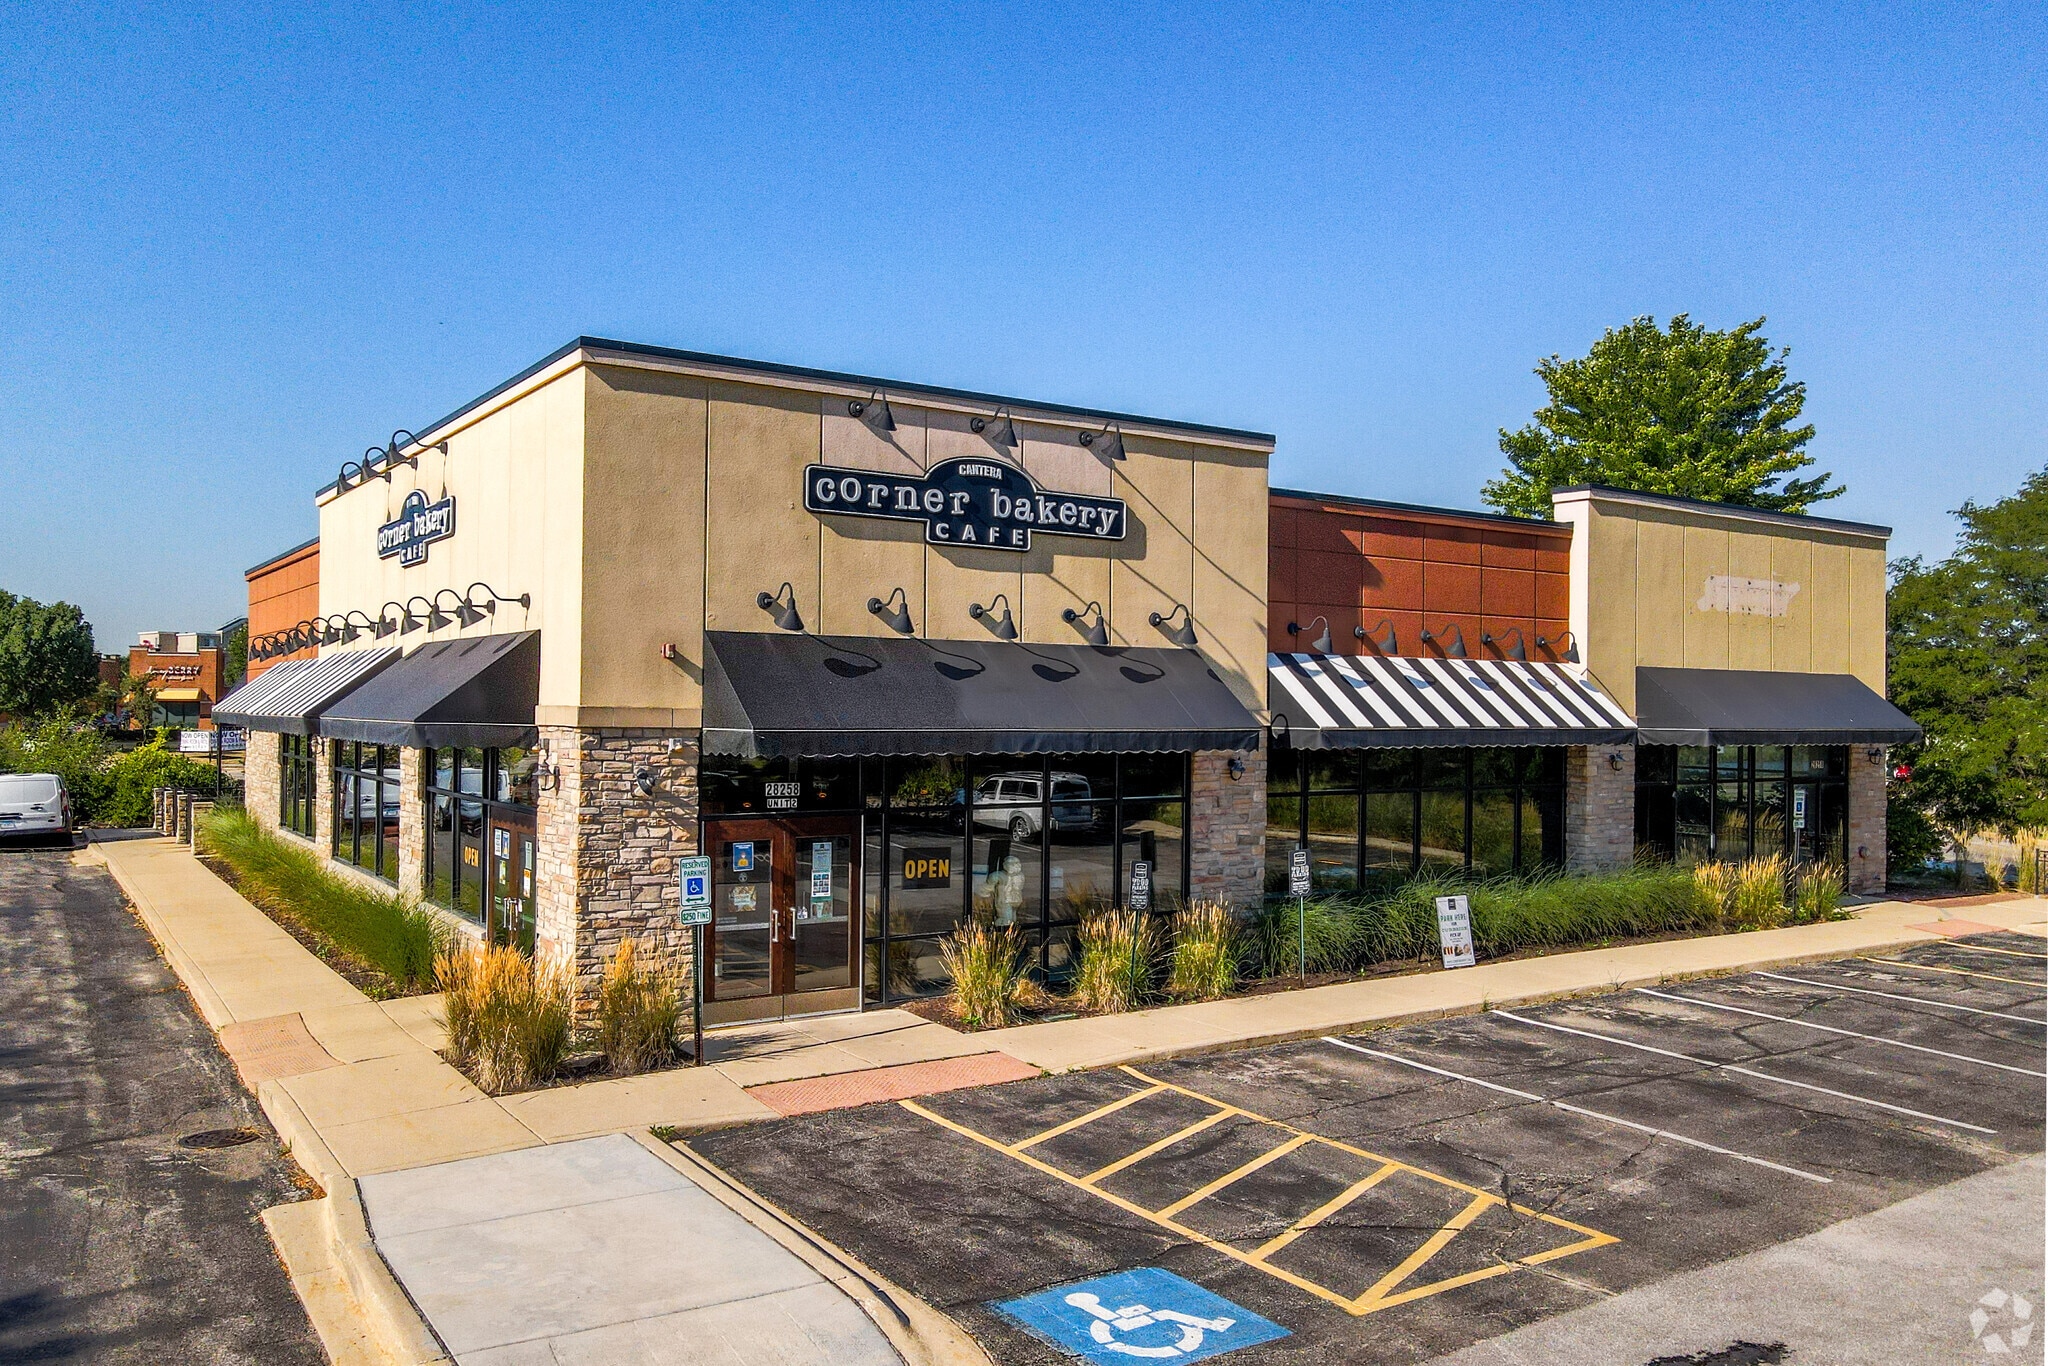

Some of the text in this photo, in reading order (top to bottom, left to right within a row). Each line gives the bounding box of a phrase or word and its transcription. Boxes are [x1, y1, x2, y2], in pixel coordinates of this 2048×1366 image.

[958, 463, 1002, 480] CANTERA
[816, 477, 1119, 535] corner bakery
[379, 507, 449, 551] corner bakery
[936, 522, 1024, 546] CAFE
[401, 543, 423, 562] CAFE
[766, 783, 799, 796] 28258
[767, 799, 790, 808] UNIT
[464, 846, 479, 867] OPEN
[682, 861, 709, 869] RESERVED
[684, 869, 707, 877] PARKING
[905, 859, 950, 879] OPEN
[683, 912, 696, 921] $250
[697, 911, 709, 920] FINE
